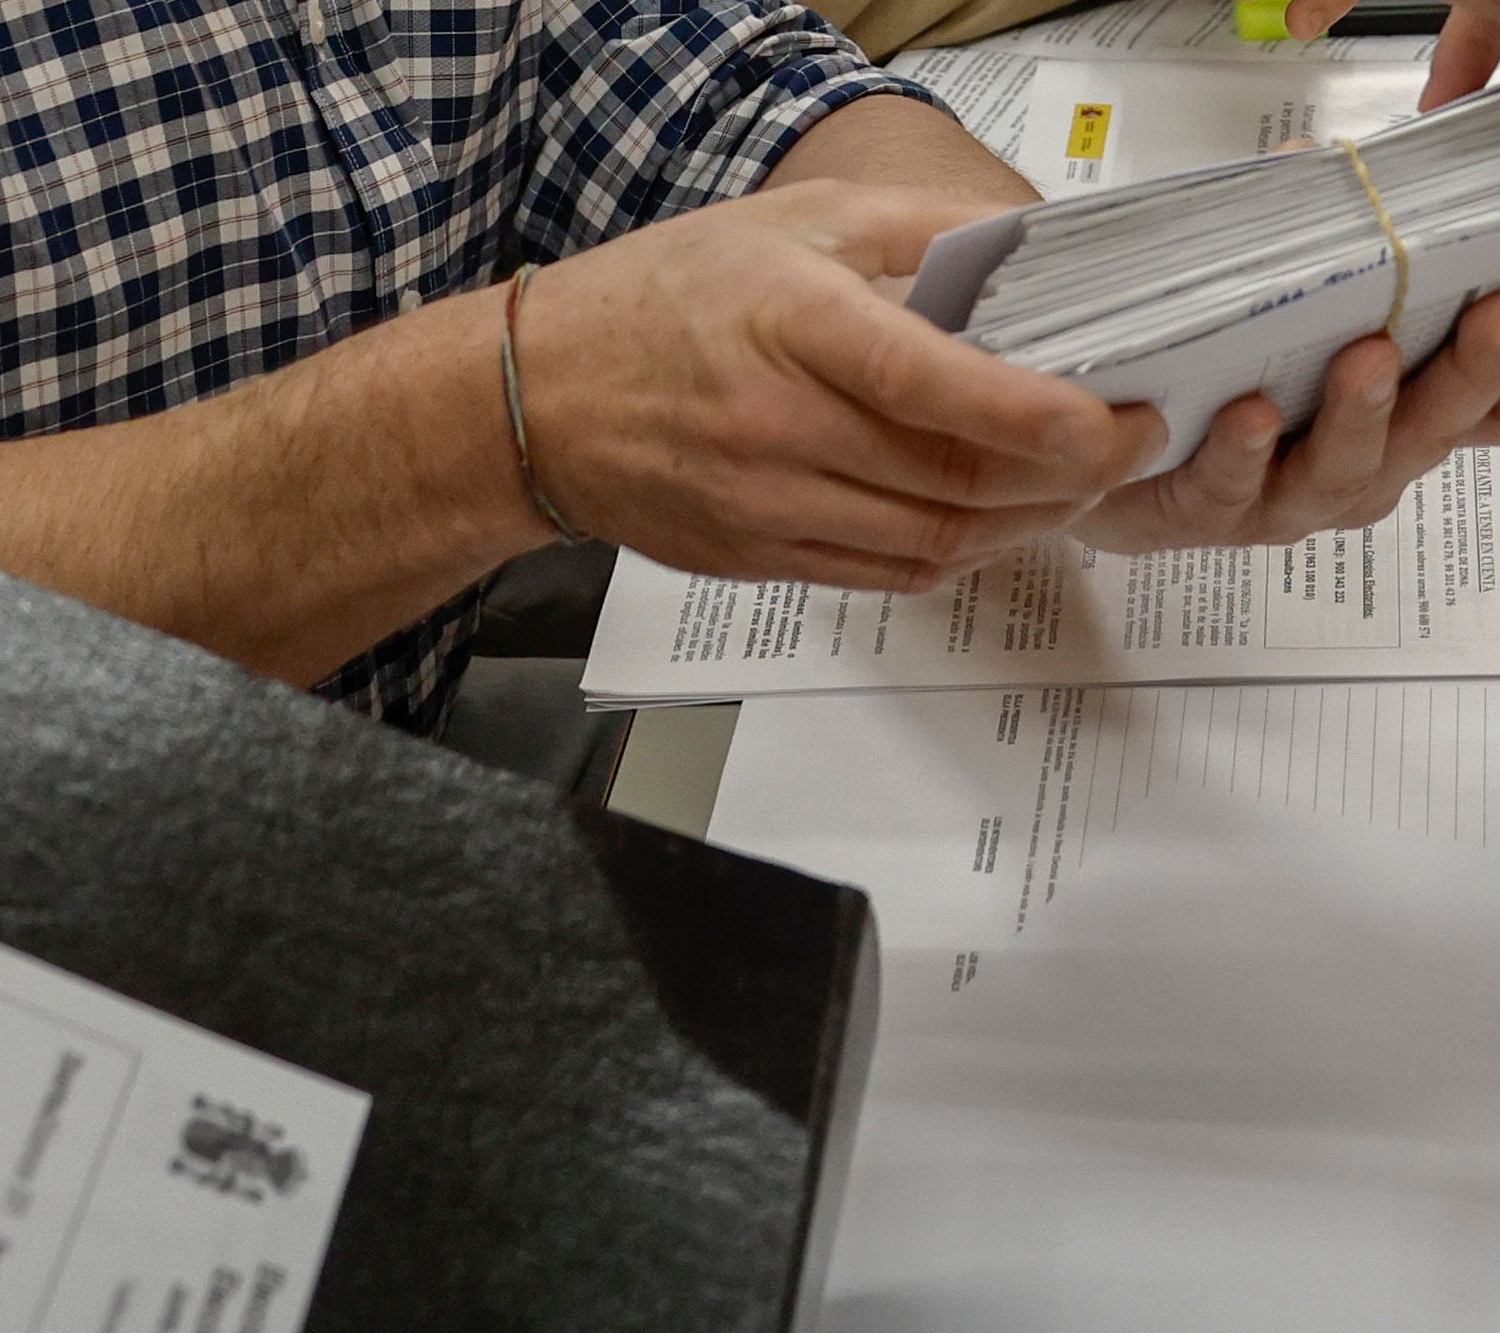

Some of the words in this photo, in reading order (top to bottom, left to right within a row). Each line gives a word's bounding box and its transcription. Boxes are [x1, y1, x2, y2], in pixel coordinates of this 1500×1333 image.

[1455, 448, 1466, 478] LÉFONOS
[1476, 446, 1493, 500] PORTANTE:
[1456, 479, 1466, 487] DE
[1456, 497, 1466, 518] JUNTA
[1457, 519, 1468, 555] ELECTORAL
[1479, 510, 1493, 541] TENER
[1481, 542, 1494, 554] EN
[1365, 550, 1376, 578] Colegios
[1417, 551, 1427, 571] sobres
[1459, 557, 1469, 565] DE
[1306, 570, 1316, 583] 100
[1481, 555, 1495, 593] CUENTA
